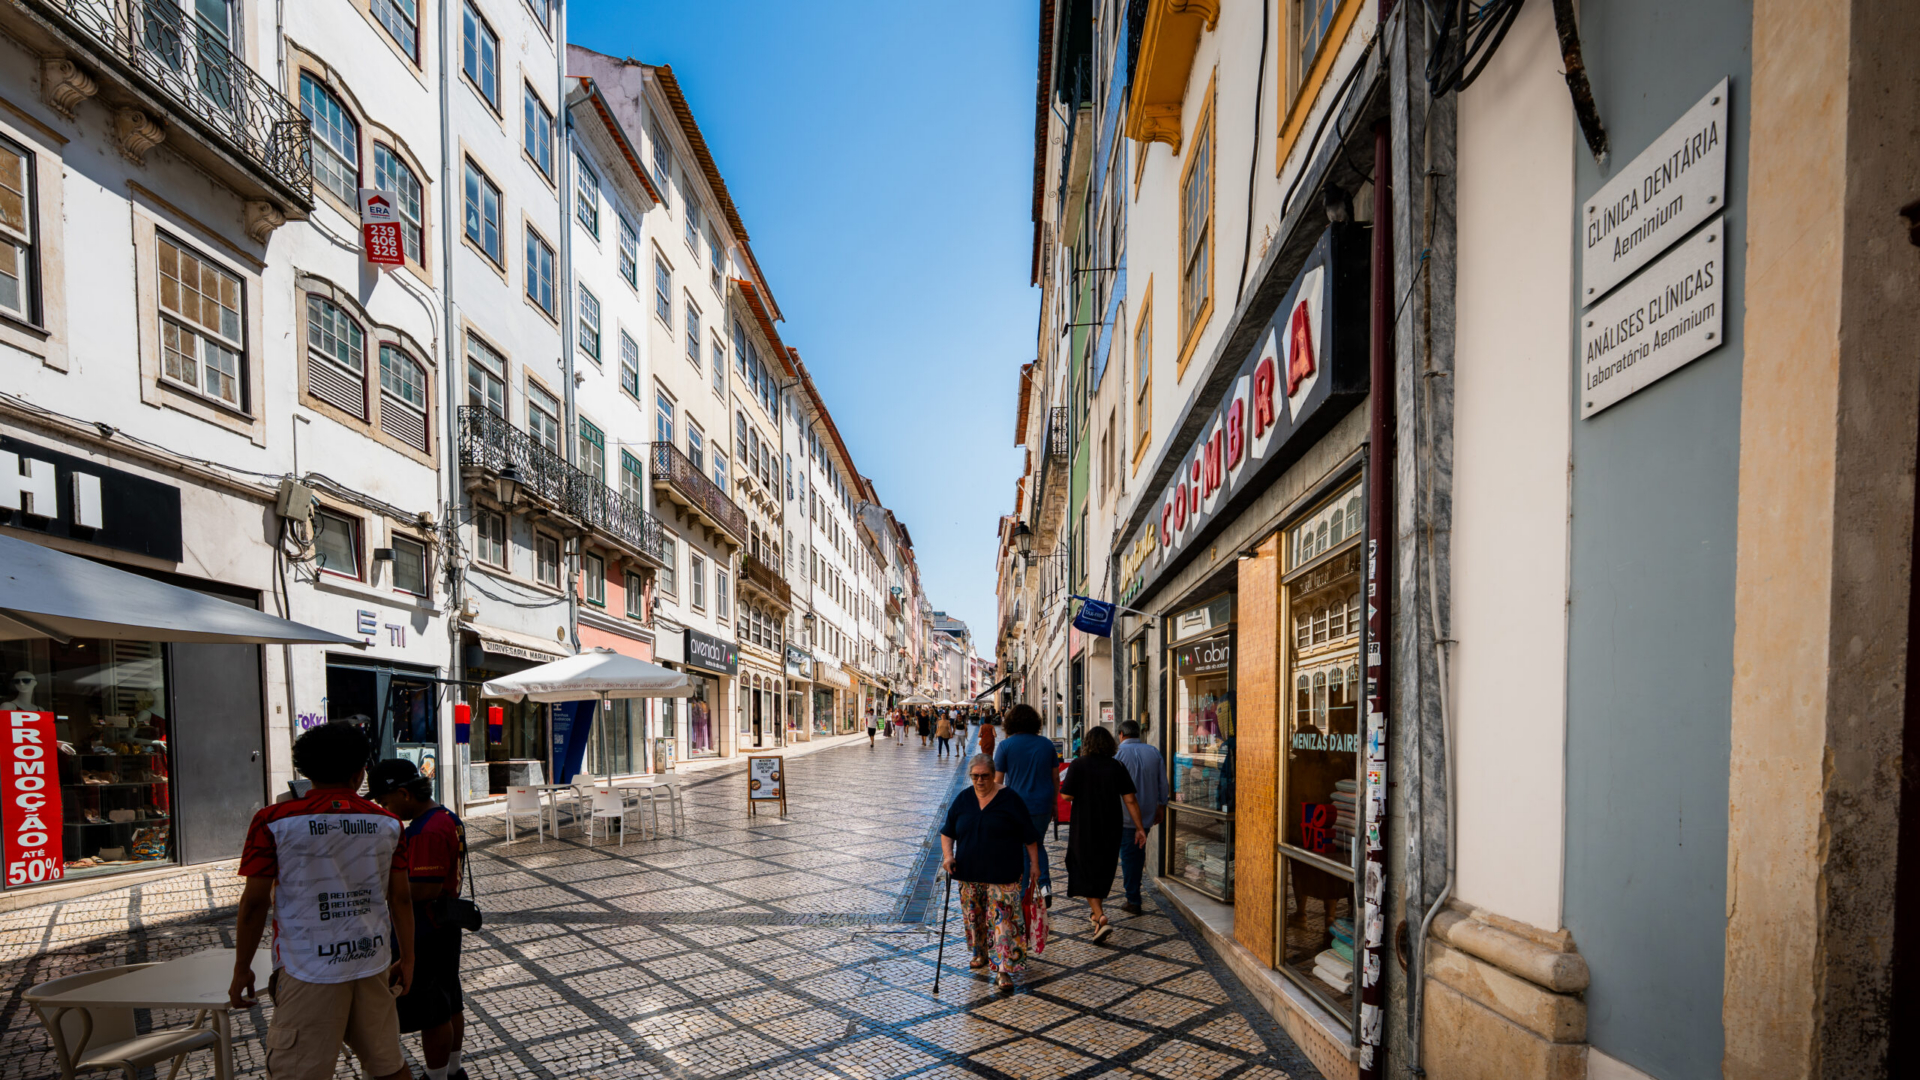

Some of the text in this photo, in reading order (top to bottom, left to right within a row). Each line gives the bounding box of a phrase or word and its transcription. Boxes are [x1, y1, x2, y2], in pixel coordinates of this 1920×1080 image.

[1588, 120, 1718, 249] CLÍNICA DENTÁRIA
[369, 206, 390, 215] ERA
[370, 225, 395, 237] 239
[1613, 195, 1683, 262] Aeminium
[371, 235, 397, 247] 406
[373, 245, 398, 257] 326
[1587, 260, 1714, 364] ANÁLISES CLÍNICAS
[1587, 303, 1715, 391] Laboratório Aeminium
[690, 638, 727, 663] avenida 7
[1292, 733, 1328, 751] MENIZAS
[10, 711, 48, 847] PROMOÇÃO
[308, 819, 328, 836] Rei
[21, 849, 45, 859] ATÉ
[8, 857, 60, 885] 50%
[328, 948, 377, 965] Authentic
